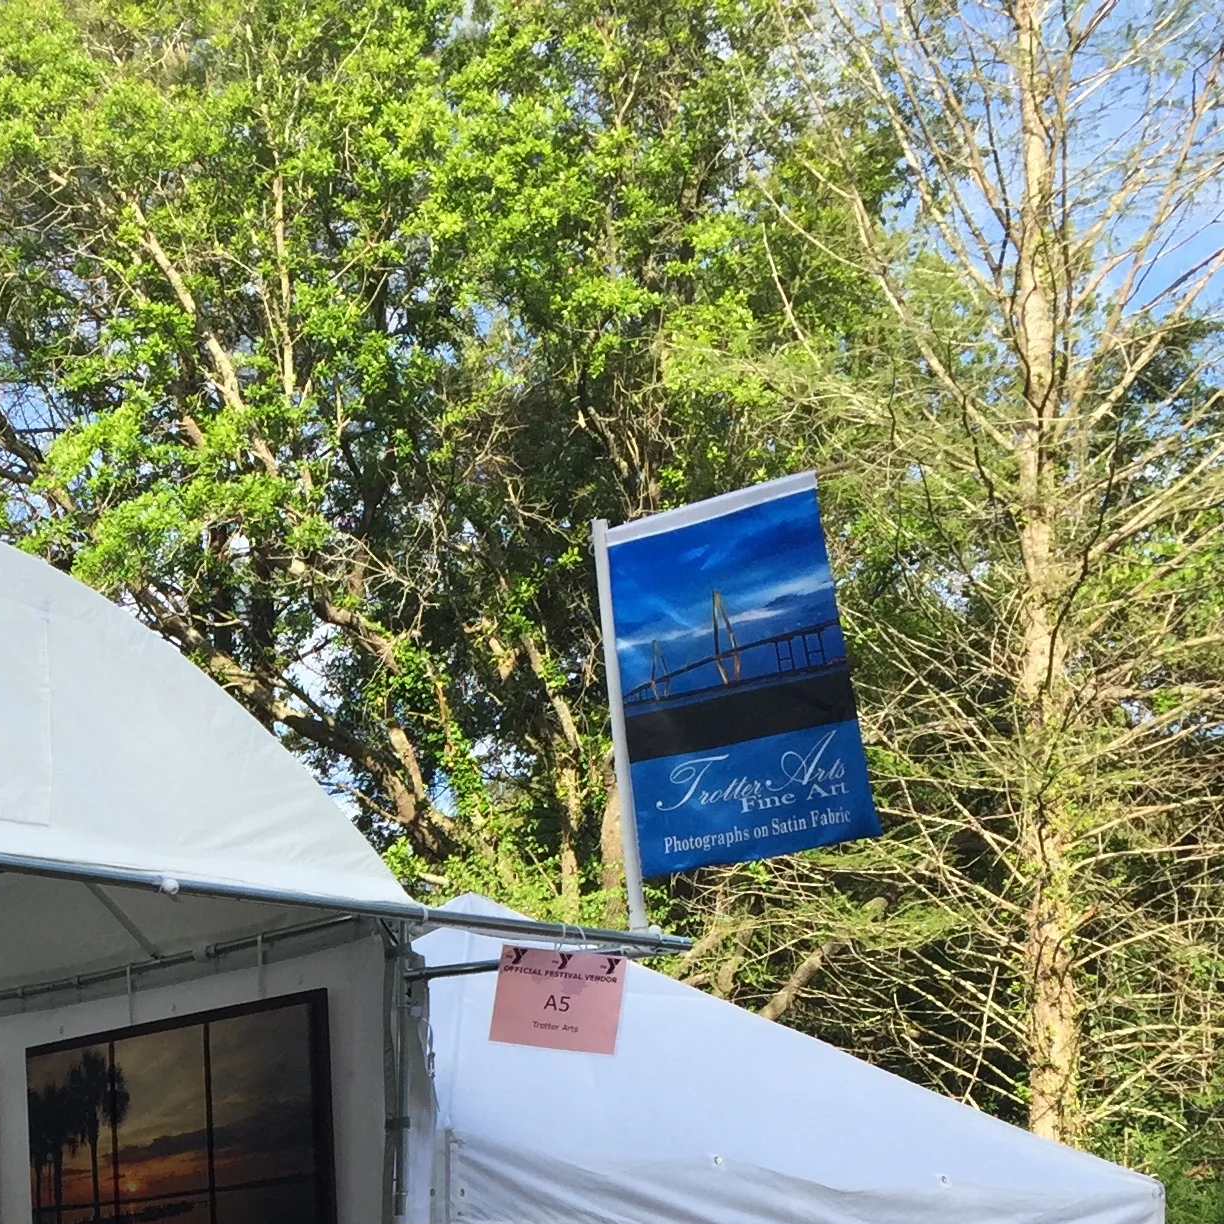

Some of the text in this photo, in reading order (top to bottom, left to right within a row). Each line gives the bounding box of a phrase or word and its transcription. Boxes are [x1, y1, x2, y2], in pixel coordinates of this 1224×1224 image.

[656, 730, 846, 812] Trotter Arts
[740, 781, 850, 814] Fine Art
[663, 806, 852, 854] Photographs on Satin Fabric
[504, 965, 617, 983] OFFICIAL FESTIVAL VENDOR
[543, 994, 571, 1012] A5
[532, 1020, 578, 1033] Trotter Arts
